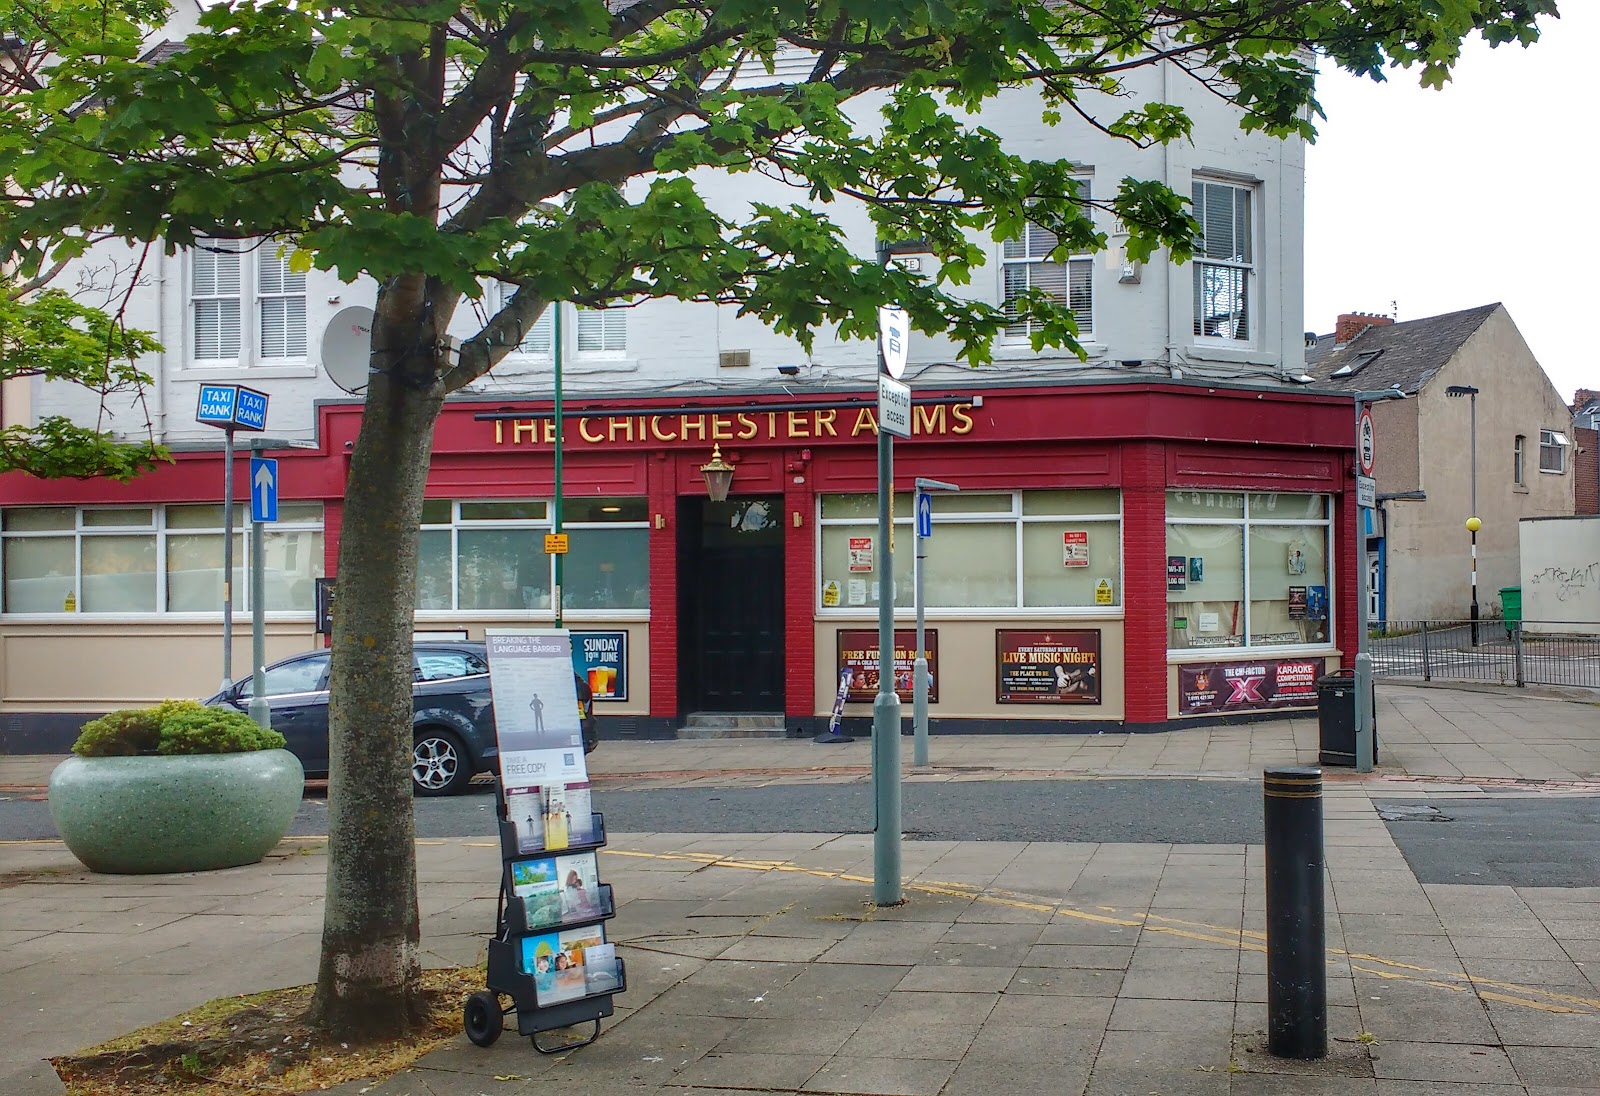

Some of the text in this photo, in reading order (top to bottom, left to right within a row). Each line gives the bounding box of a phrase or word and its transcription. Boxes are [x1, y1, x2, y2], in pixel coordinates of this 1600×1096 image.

[206, 390, 231, 403] TAXI
[882, 384, 900, 407] Except
[242, 395, 263, 411] TAXI
[201, 404, 231, 416] RANK
[238, 408, 262, 424] RANK
[495, 403, 974, 444] THE CHICHESTER AMS
[887, 409, 905, 426] access
[492, 636, 541, 645] BREAKING THE
[584, 638, 619, 651] SUNDAY
[493, 645, 561, 653] LANGUAGE BARRIER
[842, 650, 864, 659] FREE
[600, 651, 618, 662] JUNE
[1003, 652, 1095, 663] LIVE MUSIC NIGHT
[1225, 667, 1266, 676] THE CHI-FACTOR
[1277, 665, 1312, 674] KARAOKE
[505, 756, 520, 764] TAKE
[506, 762, 547, 775] FREE COPY
